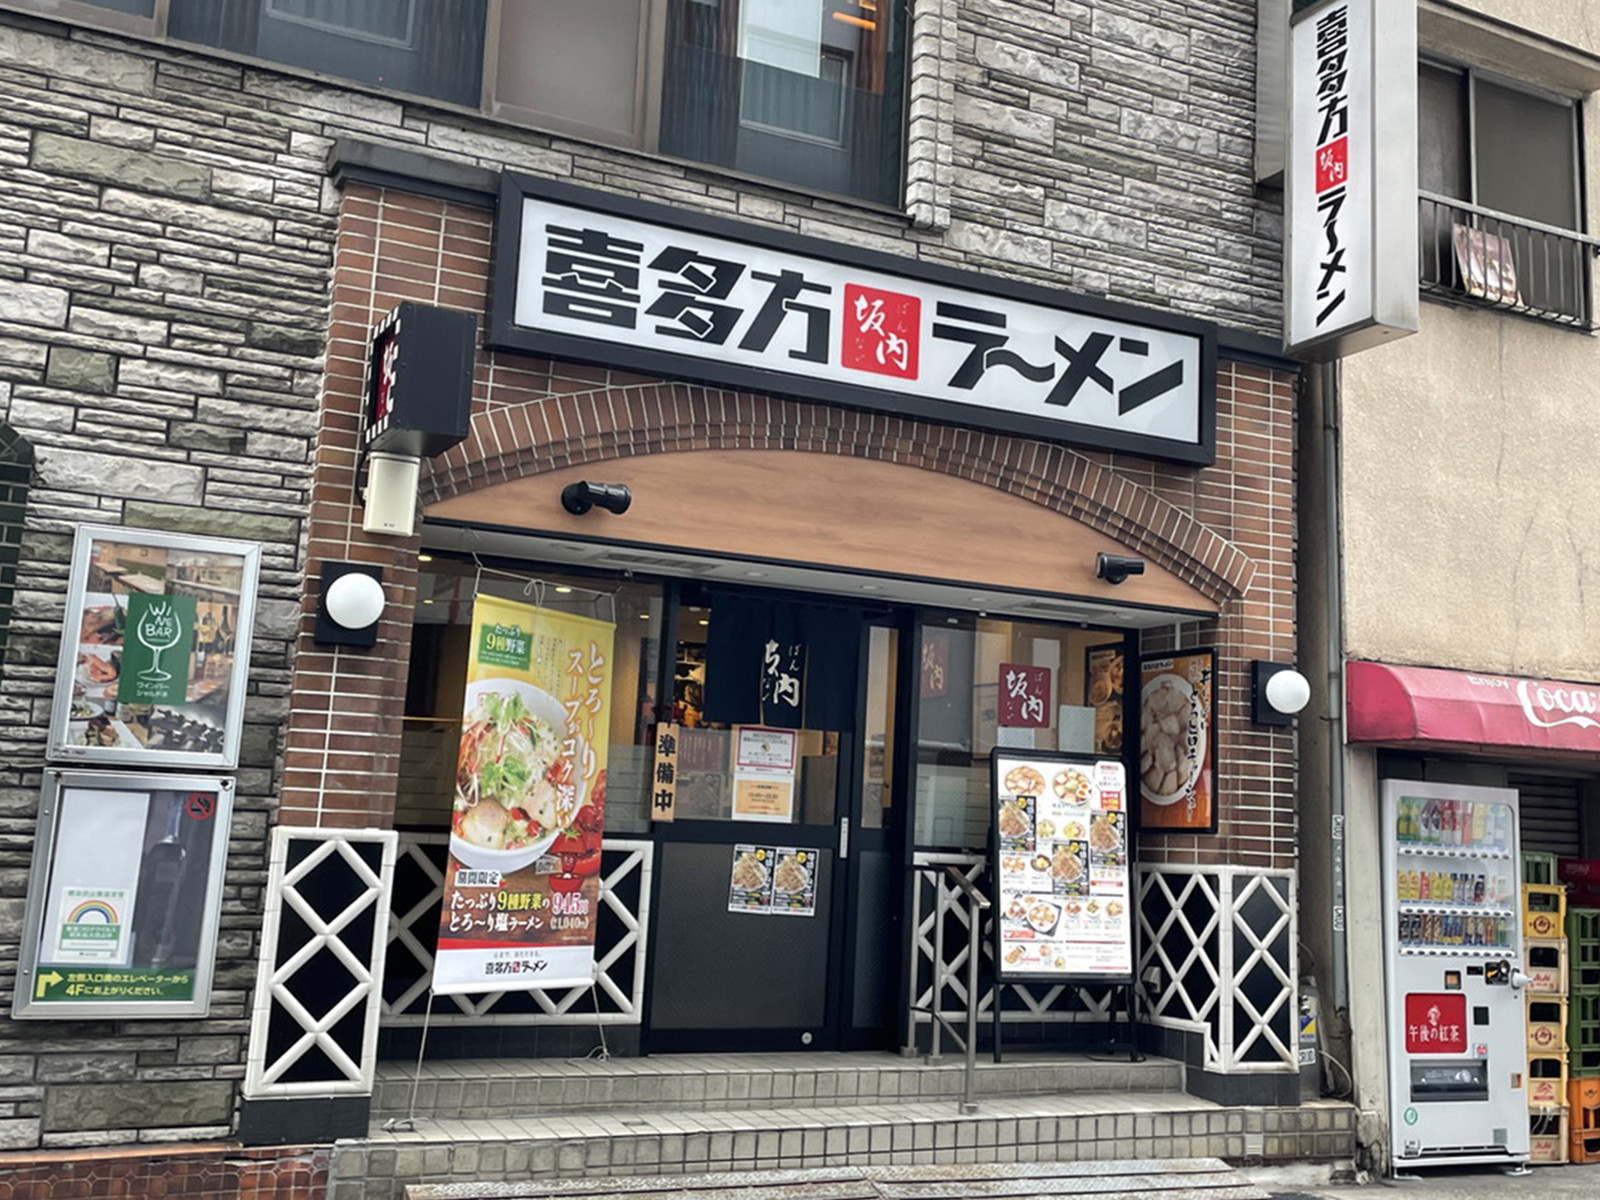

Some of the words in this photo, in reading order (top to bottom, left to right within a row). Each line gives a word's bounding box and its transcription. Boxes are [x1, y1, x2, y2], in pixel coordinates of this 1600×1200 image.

[1316, 5, 1347, 146] 喜多方
[541, 223, 832, 365] 喜多方
[853, 293, 909, 371] 坂内
[145, 623, 173, 638] BAR
[486, 633, 526, 655] 9種野菜
[1006, 670, 1043, 722] 坂内
[654, 734, 676, 812] 準備中
[457, 871, 499, 885] 期間限定
[1409, 1025, 1460, 1043] 午後の紅茶
